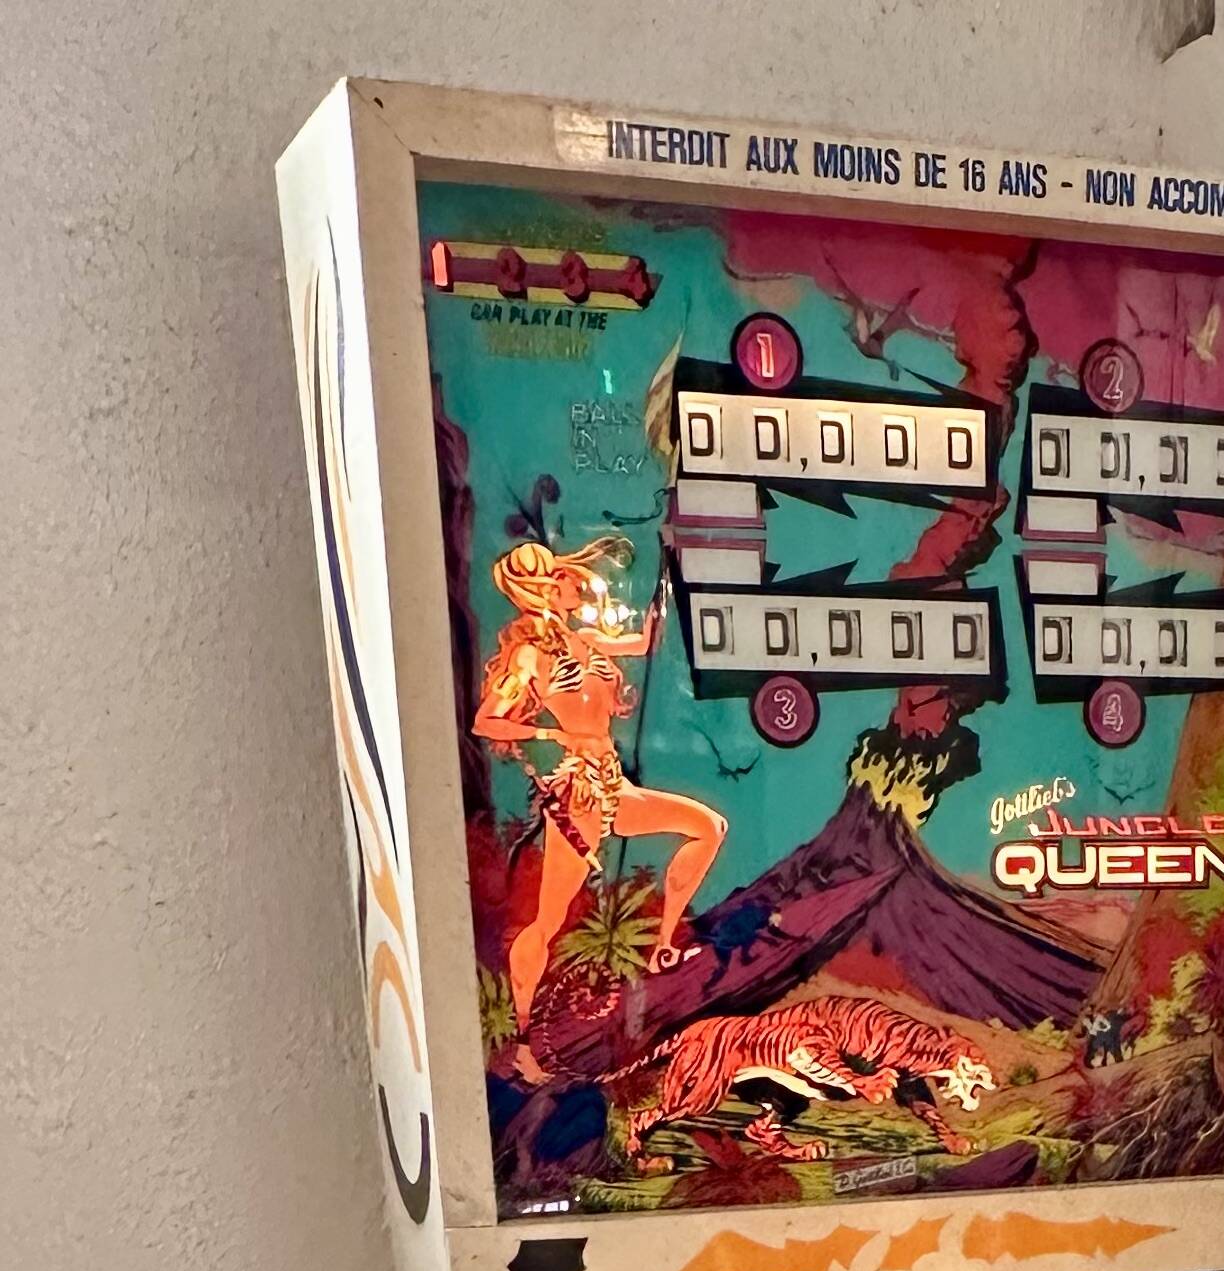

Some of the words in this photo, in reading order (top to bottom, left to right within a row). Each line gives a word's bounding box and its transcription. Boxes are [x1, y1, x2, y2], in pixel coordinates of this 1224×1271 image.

[606, 119, 731, 169] INTERDIT
[745, 134, 800, 176] AUX
[812, 141, 902, 186] MOINS
[914, 151, 948, 190] DE
[958, 158, 986, 193] 16
[998, 160, 1048, 200] ANS
[1085, 168, 1136, 208] NON
[509, 305, 551, 327] PLAY
[554, 309, 573, 328] AT
[580, 311, 608, 331] THE
[755, 332, 775, 379] 1
[1101, 356, 1124, 401] 2
[773, 688, 798, 730] 3
